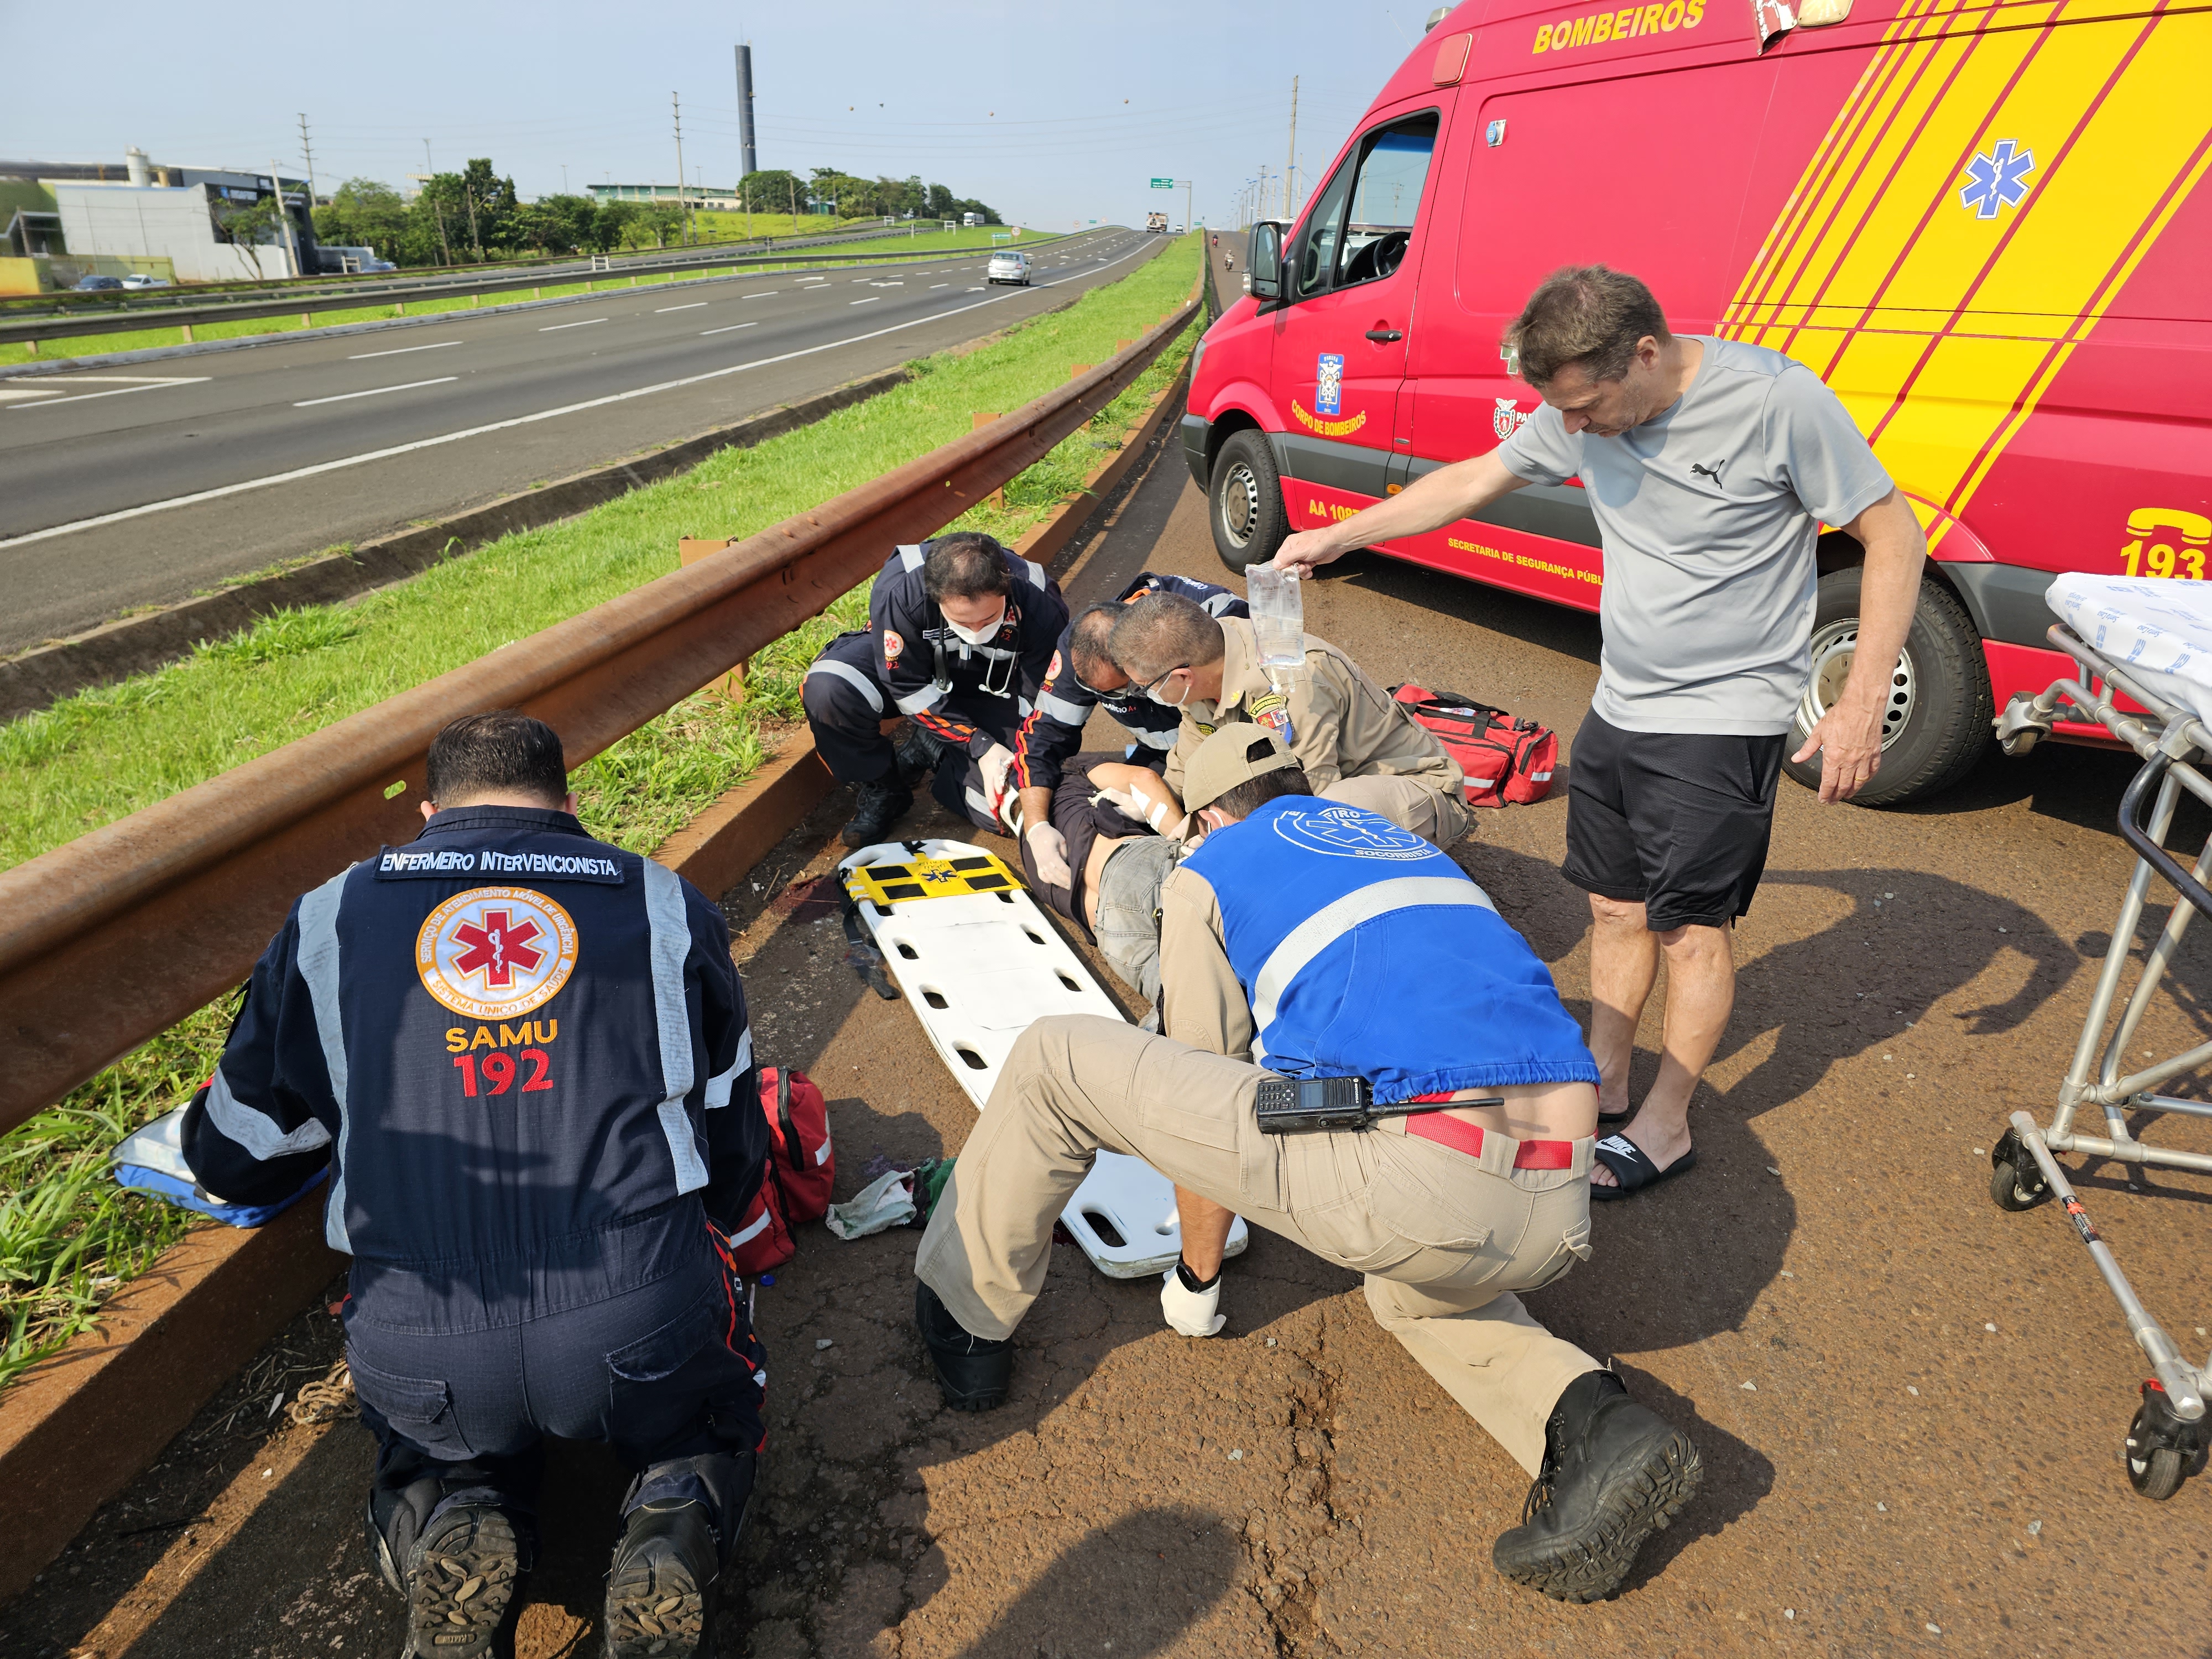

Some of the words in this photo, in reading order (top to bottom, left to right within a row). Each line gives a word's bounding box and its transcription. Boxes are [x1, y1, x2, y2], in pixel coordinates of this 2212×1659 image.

[1532, 0, 1707, 54] BOMBEIROS
[1292, 399, 1313, 429] CORPO
[1314, 418, 1324, 434] DE
[1324, 410, 1366, 436] BOMBEIROS
[1309, 499, 1327, 517] AA
[1448, 538, 1500, 560] SECRETARIA
[1502, 551, 1514, 563] DE
[1516, 555, 1575, 578] SEGURANÇA
[1577, 570, 1603, 586] PÚBL
[2120, 540, 2205, 580] 193
[380, 851, 475, 872] ENFERMEIRO
[479, 851, 618, 876] INTERVENCIONISTA
[1355, 848, 1433, 859] SOCORRISTA
[420, 924, 439, 964] SERVIÇO
[431, 912, 447, 926] DE
[444, 889, 510, 916] ATENDIMENTO
[513, 889, 544, 908] MÓVEL
[542, 904, 558, 916] DE
[554, 912, 575, 955] URGÊNCIA
[432, 979, 474, 1012] SISTEMA
[478, 1000, 518, 1015] ÚNICO
[521, 995, 539, 1009] DE
[539, 967, 567, 998] SAÚDE
[446, 1019, 558, 1052] SAMU
[454, 1048, 554, 1097] 192
[1603, 1135, 1636, 1155] NIKE
